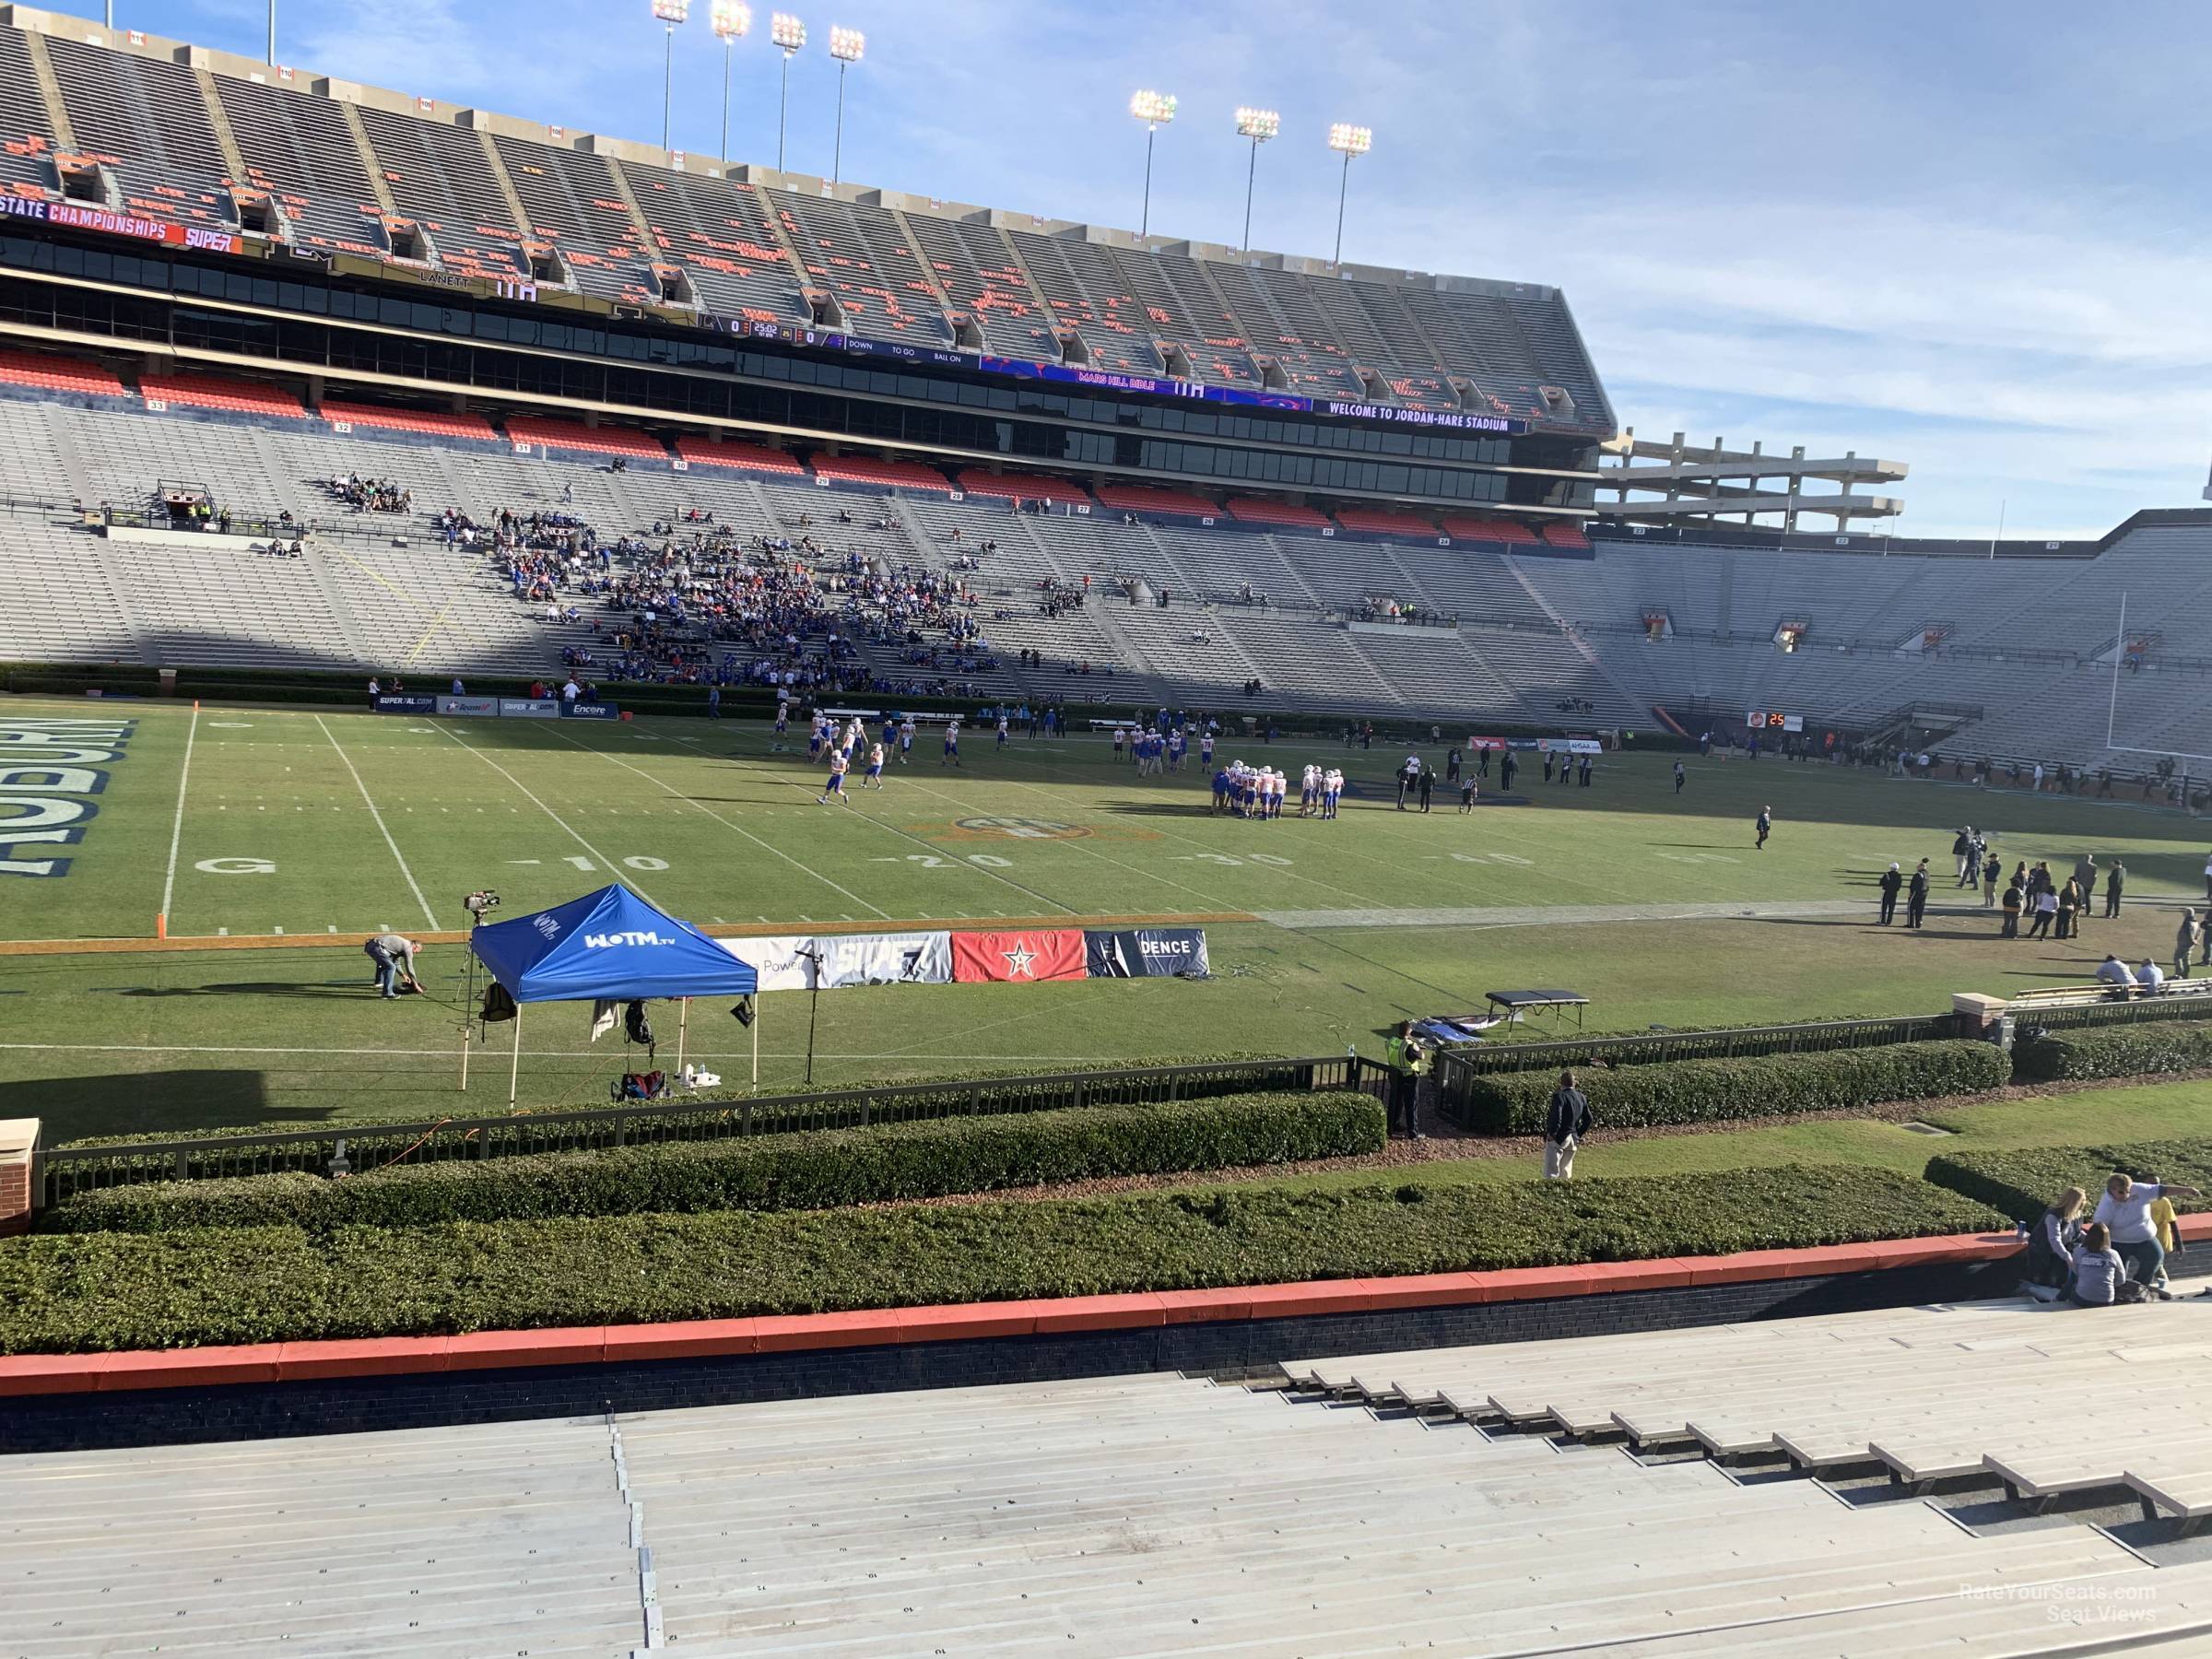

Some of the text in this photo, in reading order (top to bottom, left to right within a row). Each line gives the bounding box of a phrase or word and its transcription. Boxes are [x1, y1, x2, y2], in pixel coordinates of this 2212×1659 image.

[0, 197, 44, 218] STATE
[49, 205, 166, 240] CHAMPIONSHIPS
[420, 272, 469, 288] LANETT
[731, 321, 739, 332] 0
[754, 323, 778, 333] 25:02
[806, 332, 814, 343] 0
[849, 340, 873, 350] DOWN
[934, 353, 961, 363] BALL ON
[1078, 371, 1156, 391] MARS HILL BIBLE
[1330, 402, 1508, 431] WELCOME TO JORDAN-HARE STADIUM
[573, 704, 606, 715] Encore
[1770, 714, 1784, 725] 25
[0, 716, 139, 877] BURN
[564, 856, 671, 871] 10
[907, 854, 1013, 868] 20
[1197, 853, 1295, 865] 30
[194, 858, 276, 874] G
